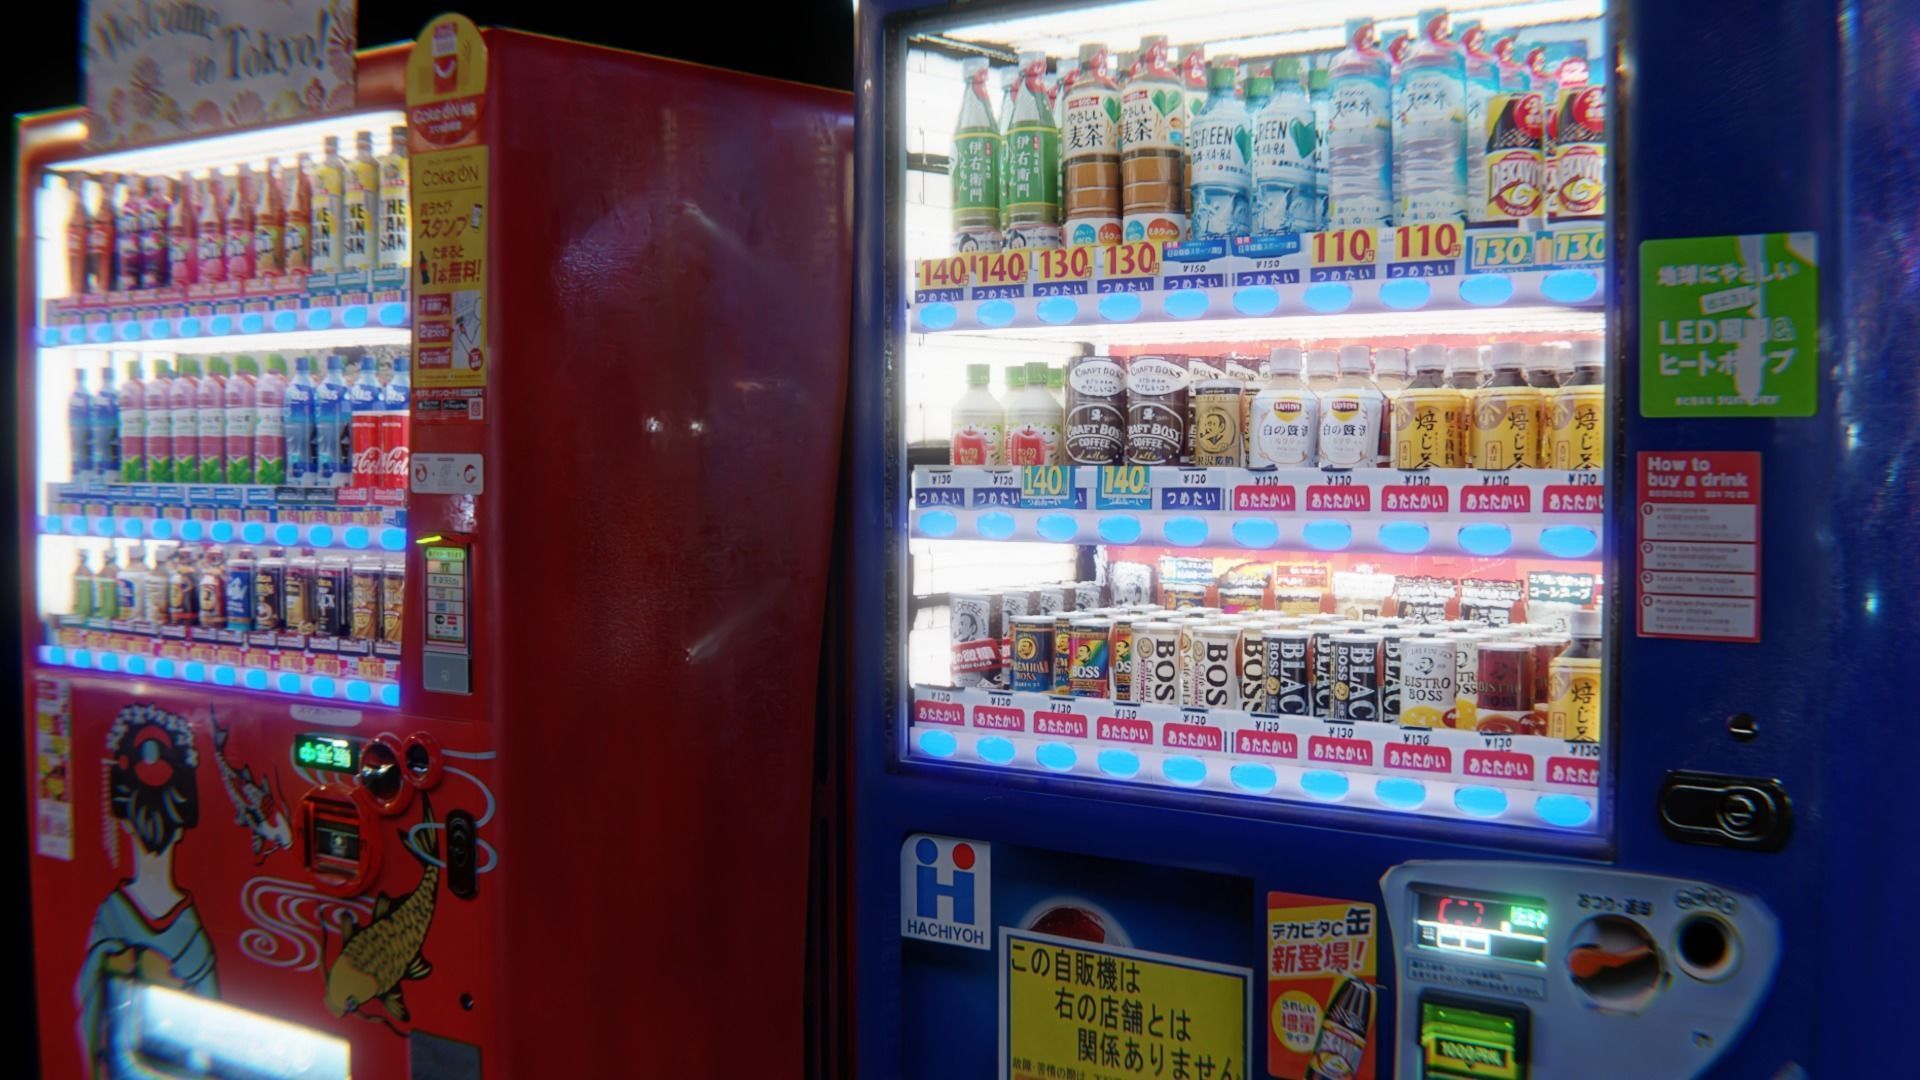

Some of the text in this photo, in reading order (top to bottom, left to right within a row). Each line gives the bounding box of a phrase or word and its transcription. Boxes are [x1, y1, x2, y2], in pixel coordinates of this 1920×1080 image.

[96, 0, 220, 60] Welcome
[189, 8, 330, 85] to Tokyo!
[1067, 109, 1103, 124] やさしい
[1069, 124, 1104, 150] 麦茶
[1123, 117, 1153, 146] 麦茶
[1192, 126, 1233, 149] GREEN
[969, 141, 983, 202] 伊右衛門
[1016, 135, 1030, 198] 伊右衛門
[419, 213, 470, 239] スタンプ
[1183, 264, 1206, 273] ¥150
[1255, 259, 1280, 269] ¥150
[1392, 263, 1450, 278] つめたい
[1168, 275, 1219, 289] つめたい
[1241, 271, 1295, 286] つめたい
[1315, 267, 1371, 281] つめたい
[976, 288, 1021, 300] つめたい
[1037, 283, 1083, 296] つめたい
[1102, 280, 1149, 293] つめたい
[917, 291, 961, 303] つめたい
[1275, 402, 1301, 411] Lipton
[1332, 400, 1358, 410] Lipton
[1068, 424, 1099, 438] CRAFT
[1151, 423, 1182, 442] BOSS
[1079, 437, 1110, 448] COFFEE
[1134, 437, 1163, 448] COFFEE
[1648, 456, 1711, 471] How to
[1648, 471, 1749, 487] buy a drink
[918, 491, 961, 505] つめたい
[976, 491, 1020, 506] つめたい
[1166, 490, 1216, 506] つめたい
[1238, 492, 1291, 509] あたたかい
[1311, 492, 1365, 509] あたたかい
[1386, 493, 1444, 510] あたたかい
[1465, 493, 1526, 510] あたたかい
[1269, 642, 1279, 677] BOSS
[1337, 647, 1349, 681] BOSS
[1071, 665, 1100, 678] BOSS
[1154, 638, 1176, 703] BOS
[1205, 642, 1229, 707] BOS
[1280, 641, 1306, 714] BLAC
[1349, 646, 1375, 720] BLAC
[1404, 677, 1451, 689] BISTRO
[1408, 689, 1444, 702] BOSS
[918, 706, 961, 721] あたたかい
[977, 711, 1021, 728] あたたかい
[1037, 717, 1084, 734] あたたかい
[1101, 722, 1149, 740] あたたかい
[1167, 729, 1217, 746] あたたかい
[1241, 735, 1293, 754] あたたかい
[1313, 743, 1368, 761] あたたかい
[1389, 750, 1447, 768] あたたかい
[1468, 757, 1529, 776] あたたかい
[907, 919, 985, 945] HACHIYOH
[1011, 944, 1141, 993] この自販機は
[1055, 986, 1192, 1041] 右の店舗とは
